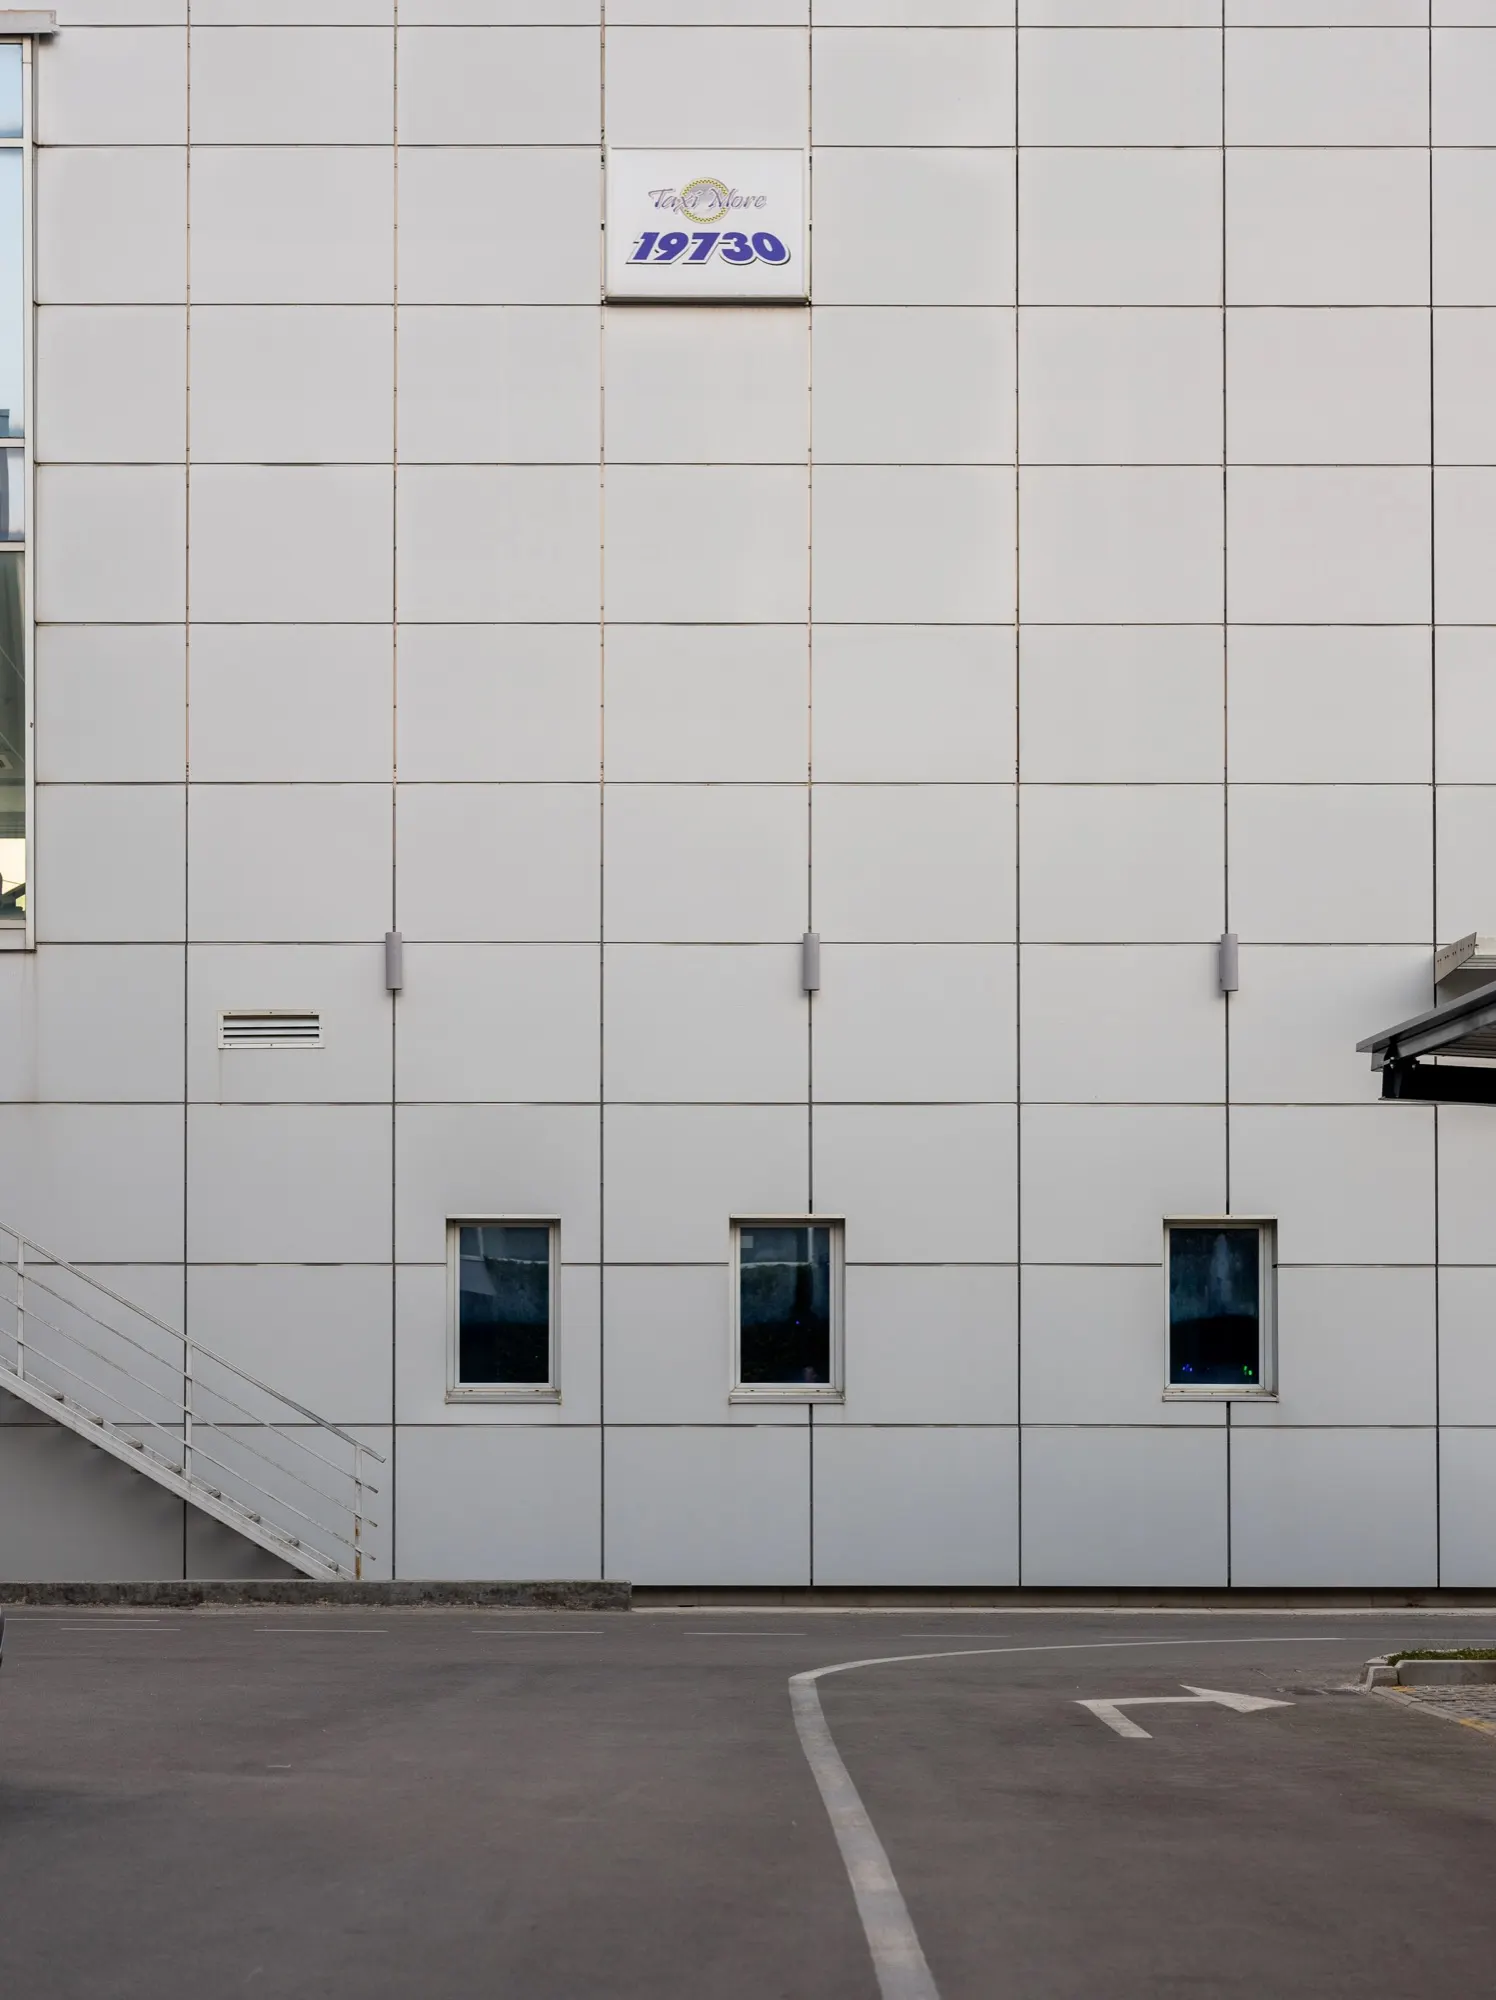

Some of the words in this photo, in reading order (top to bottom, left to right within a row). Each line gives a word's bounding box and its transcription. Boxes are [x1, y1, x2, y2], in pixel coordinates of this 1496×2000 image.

[648, 188, 704, 214] Taxi
[708, 187, 766, 209] More
[630, 231, 788, 262] 19730
